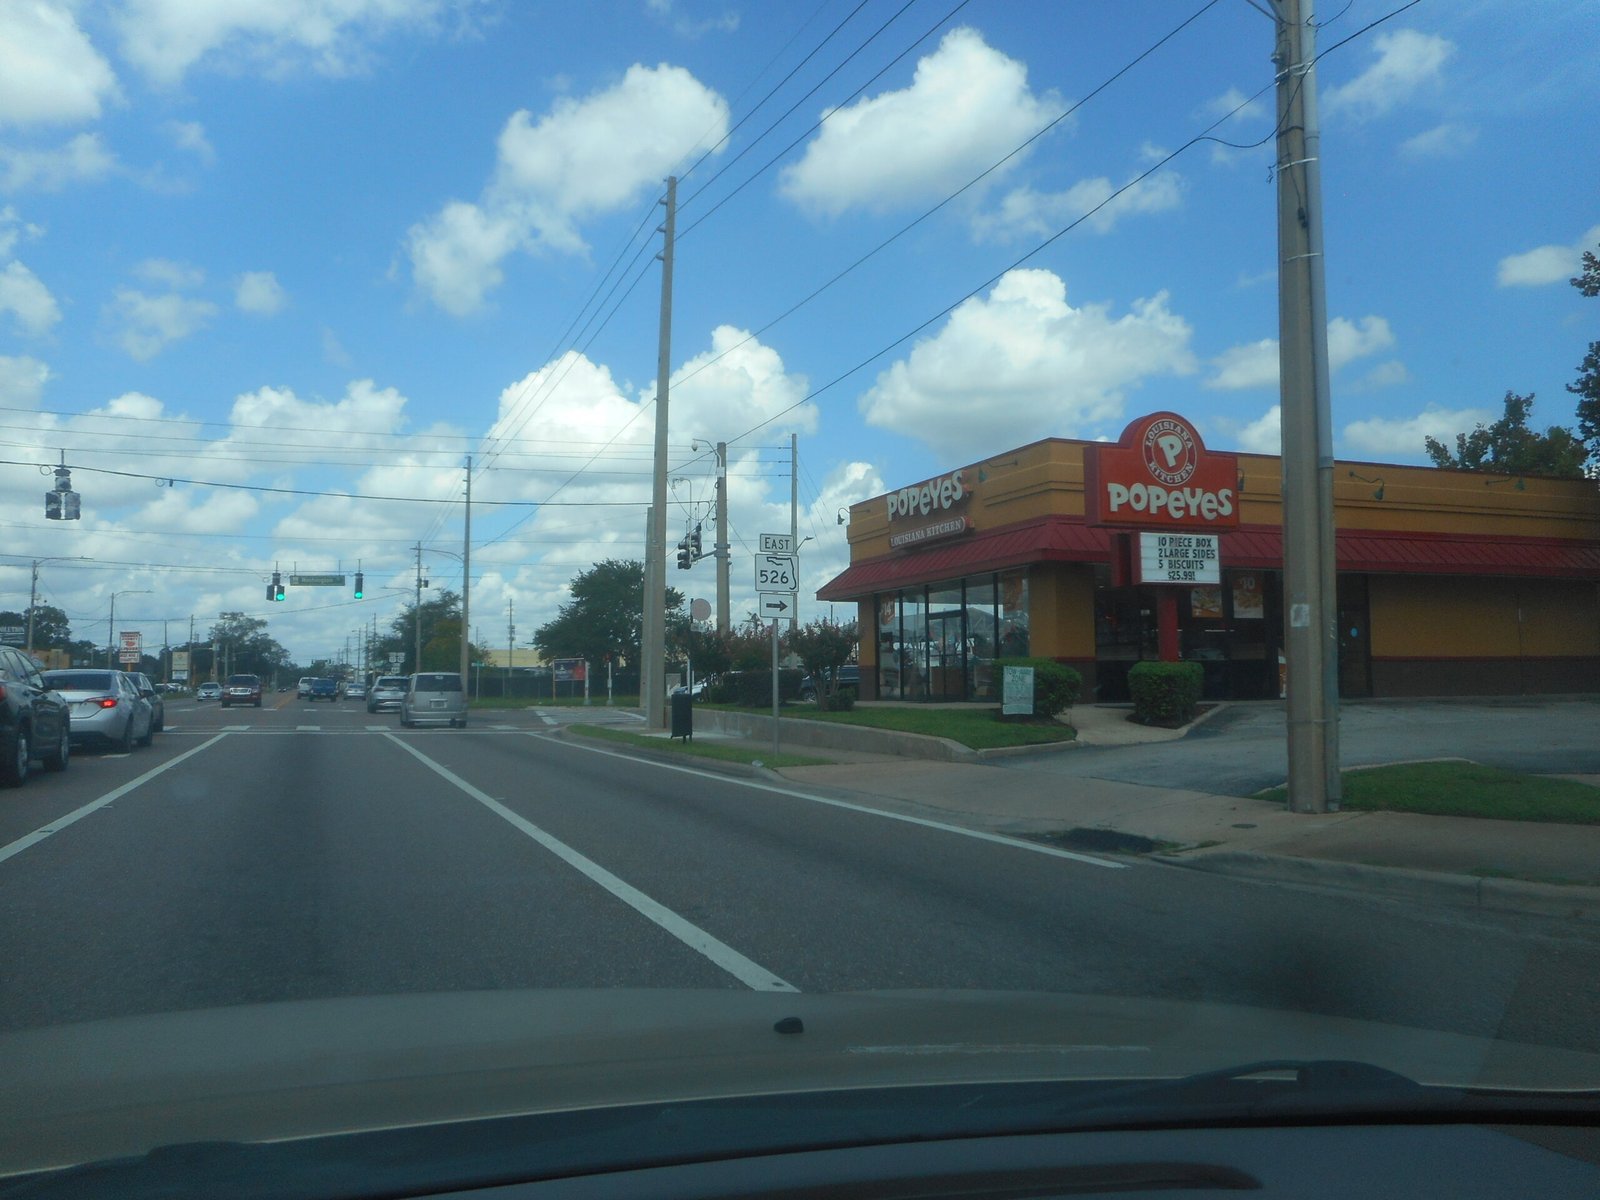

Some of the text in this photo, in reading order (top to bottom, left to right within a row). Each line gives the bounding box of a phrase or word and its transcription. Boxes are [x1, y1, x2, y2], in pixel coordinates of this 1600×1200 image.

[1145, 421, 1193, 449] LOUISIANA
[1157, 435, 1183, 467] P
[1148, 462, 1194, 483] KITCHEN
[891, 519, 962, 547] LOUISIANA KITCHEN
[764, 537, 790, 550] EAST
[1158, 537, 1212, 548] 10 PIECE BOX
[1158, 549, 1215, 559] 2 LARGE SIDES
[1158, 560, 1205, 570] 5 BISCUITS
[760, 570, 789, 584] 526
